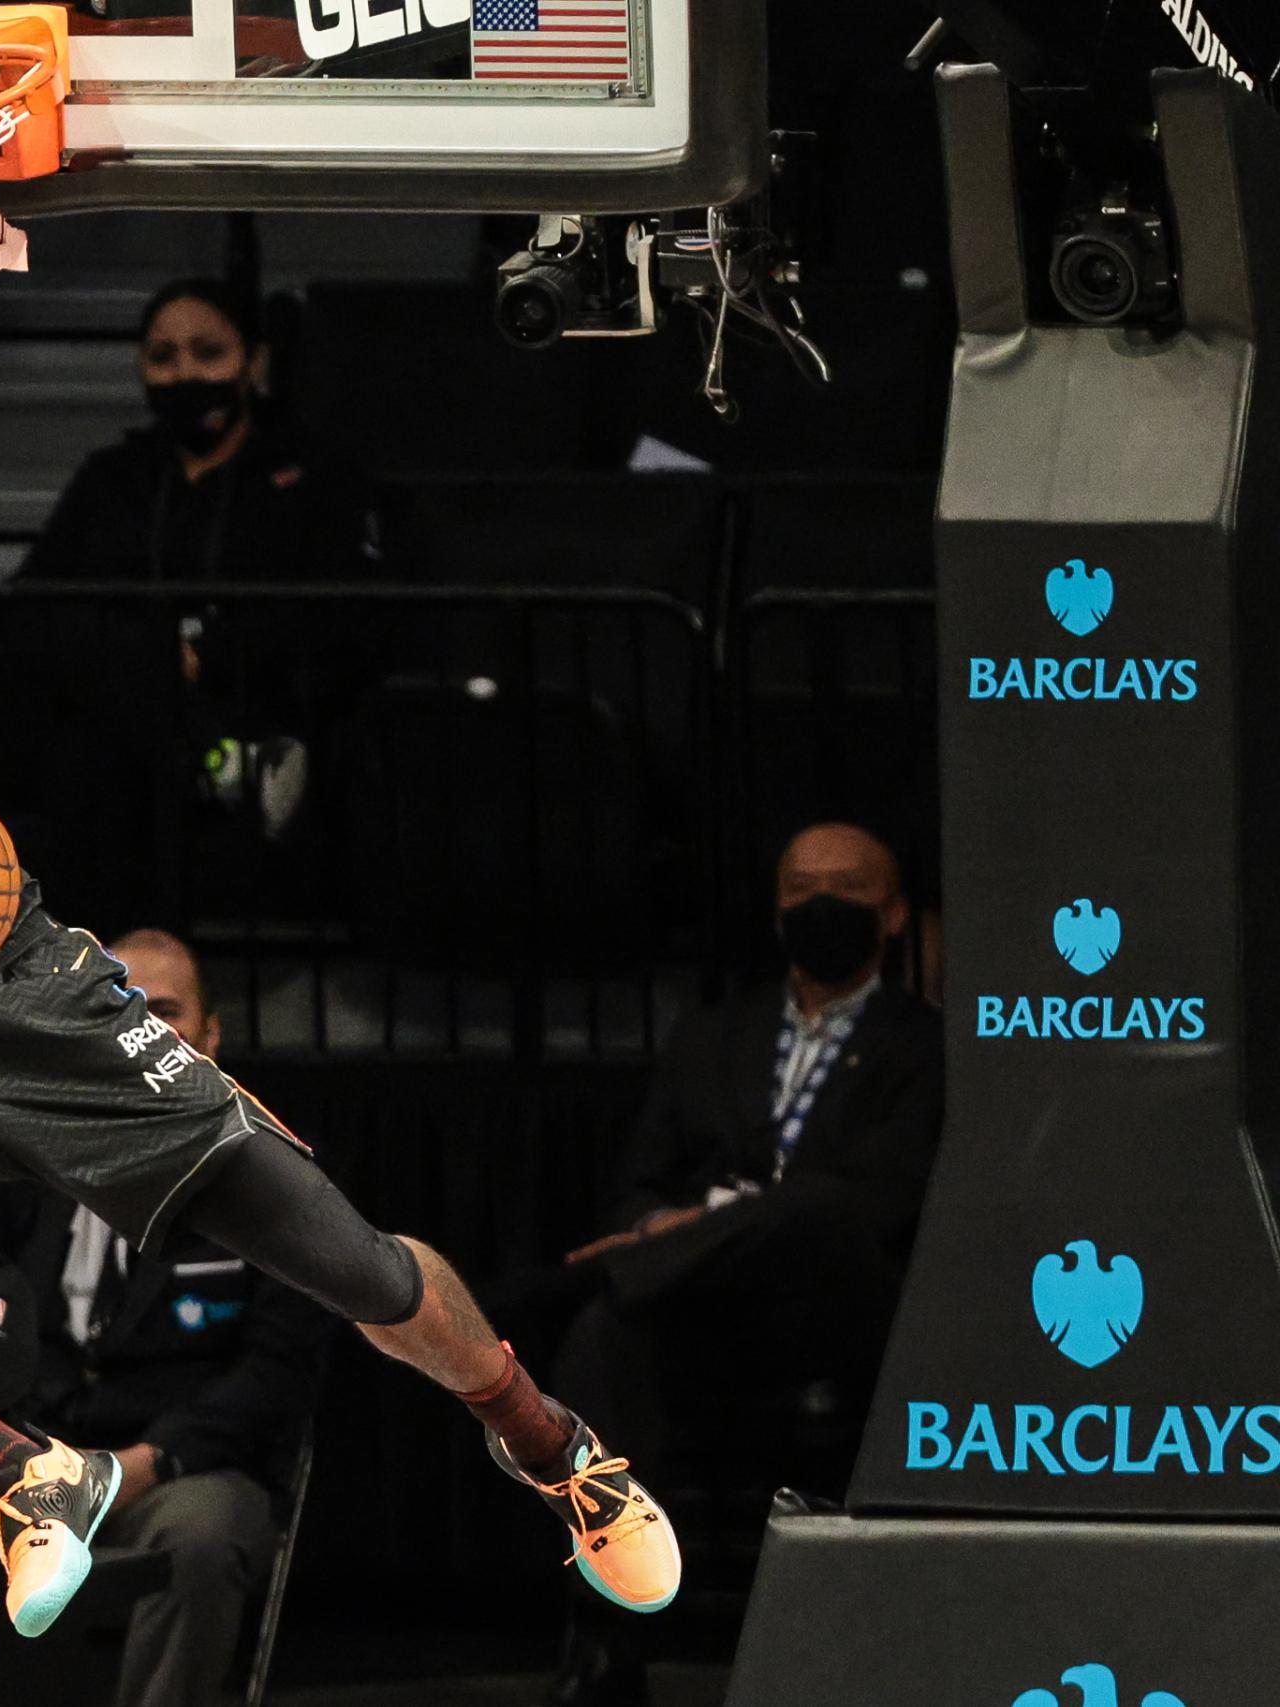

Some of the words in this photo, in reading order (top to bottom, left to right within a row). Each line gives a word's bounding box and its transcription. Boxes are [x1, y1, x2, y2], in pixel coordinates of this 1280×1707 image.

[968, 657, 1198, 700] BARCLAYS
[976, 996, 1206, 1040] BARCLAYS
[904, 1401, 1280, 1475] BARCLAYS
